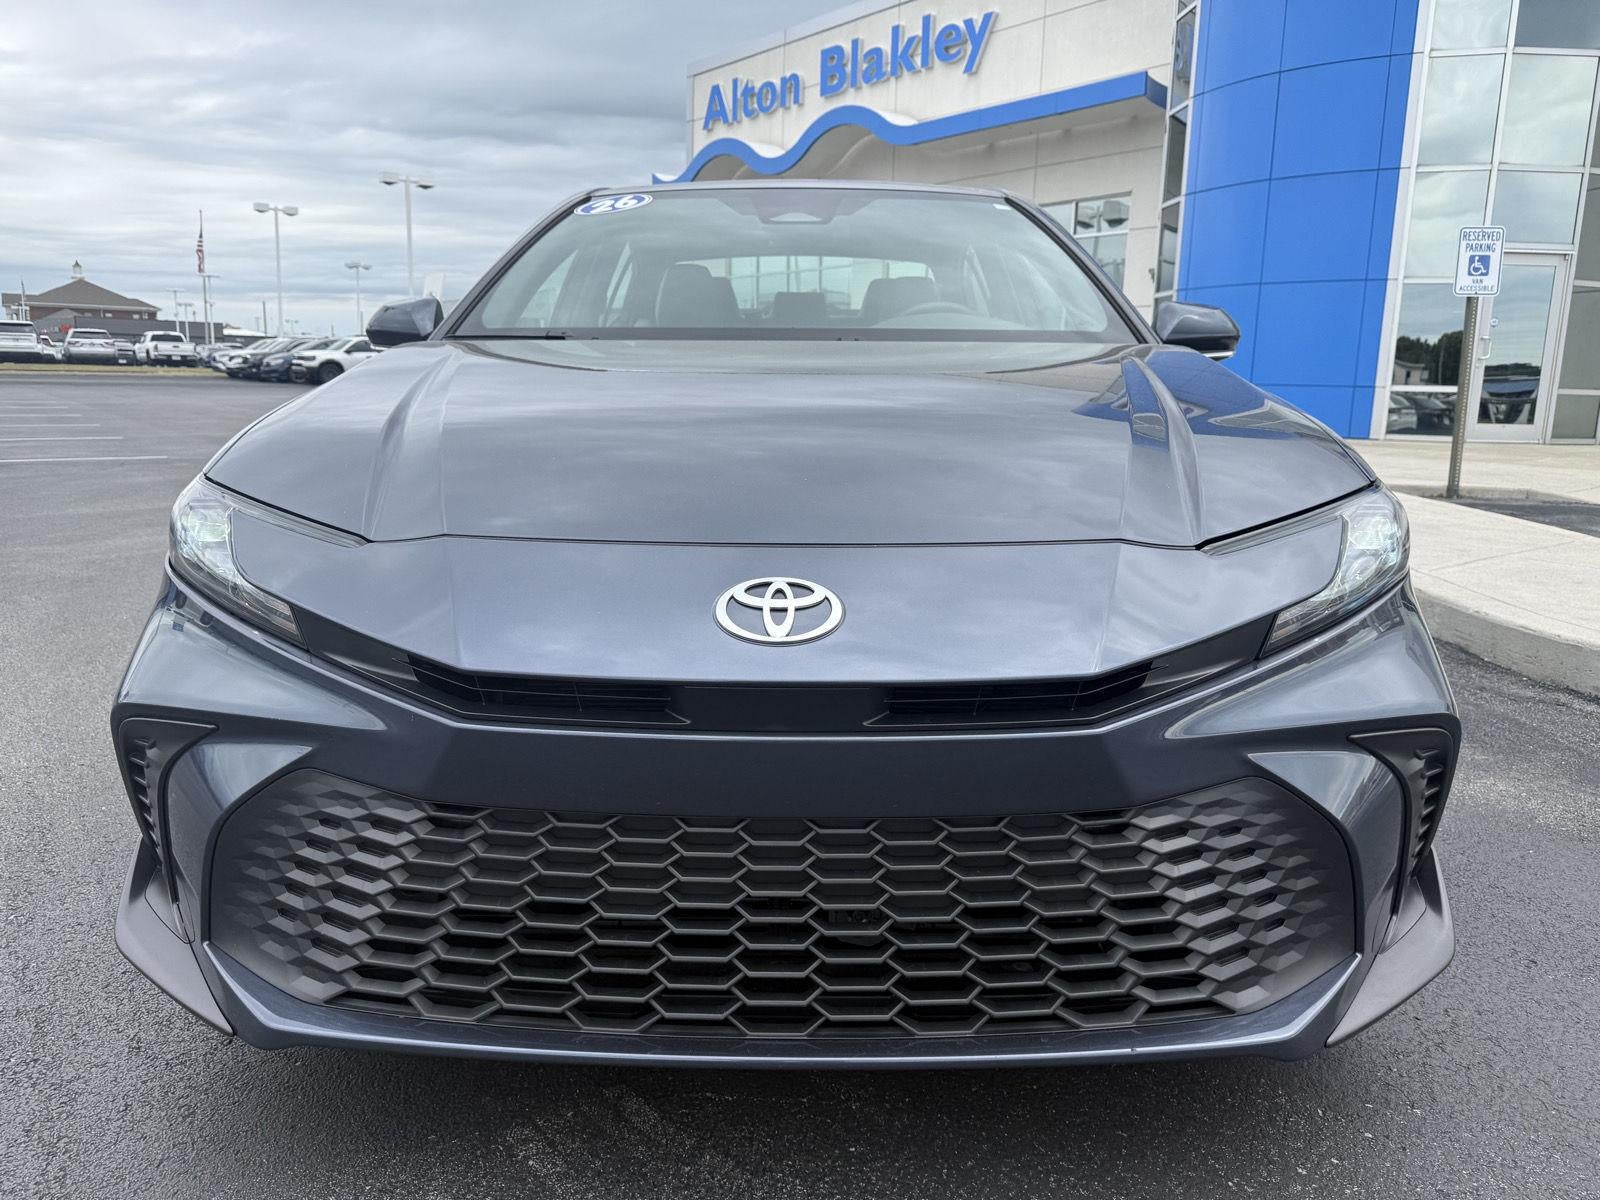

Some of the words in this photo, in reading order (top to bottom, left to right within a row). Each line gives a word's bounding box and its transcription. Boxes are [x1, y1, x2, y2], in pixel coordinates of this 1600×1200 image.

[702, 72, 803, 131] Alton
[819, 11, 998, 98] Blakley
[589, 195, 638, 214] 26
[1462, 230, 1501, 241] RESERVED
[1465, 242, 1496, 253] PARKING
